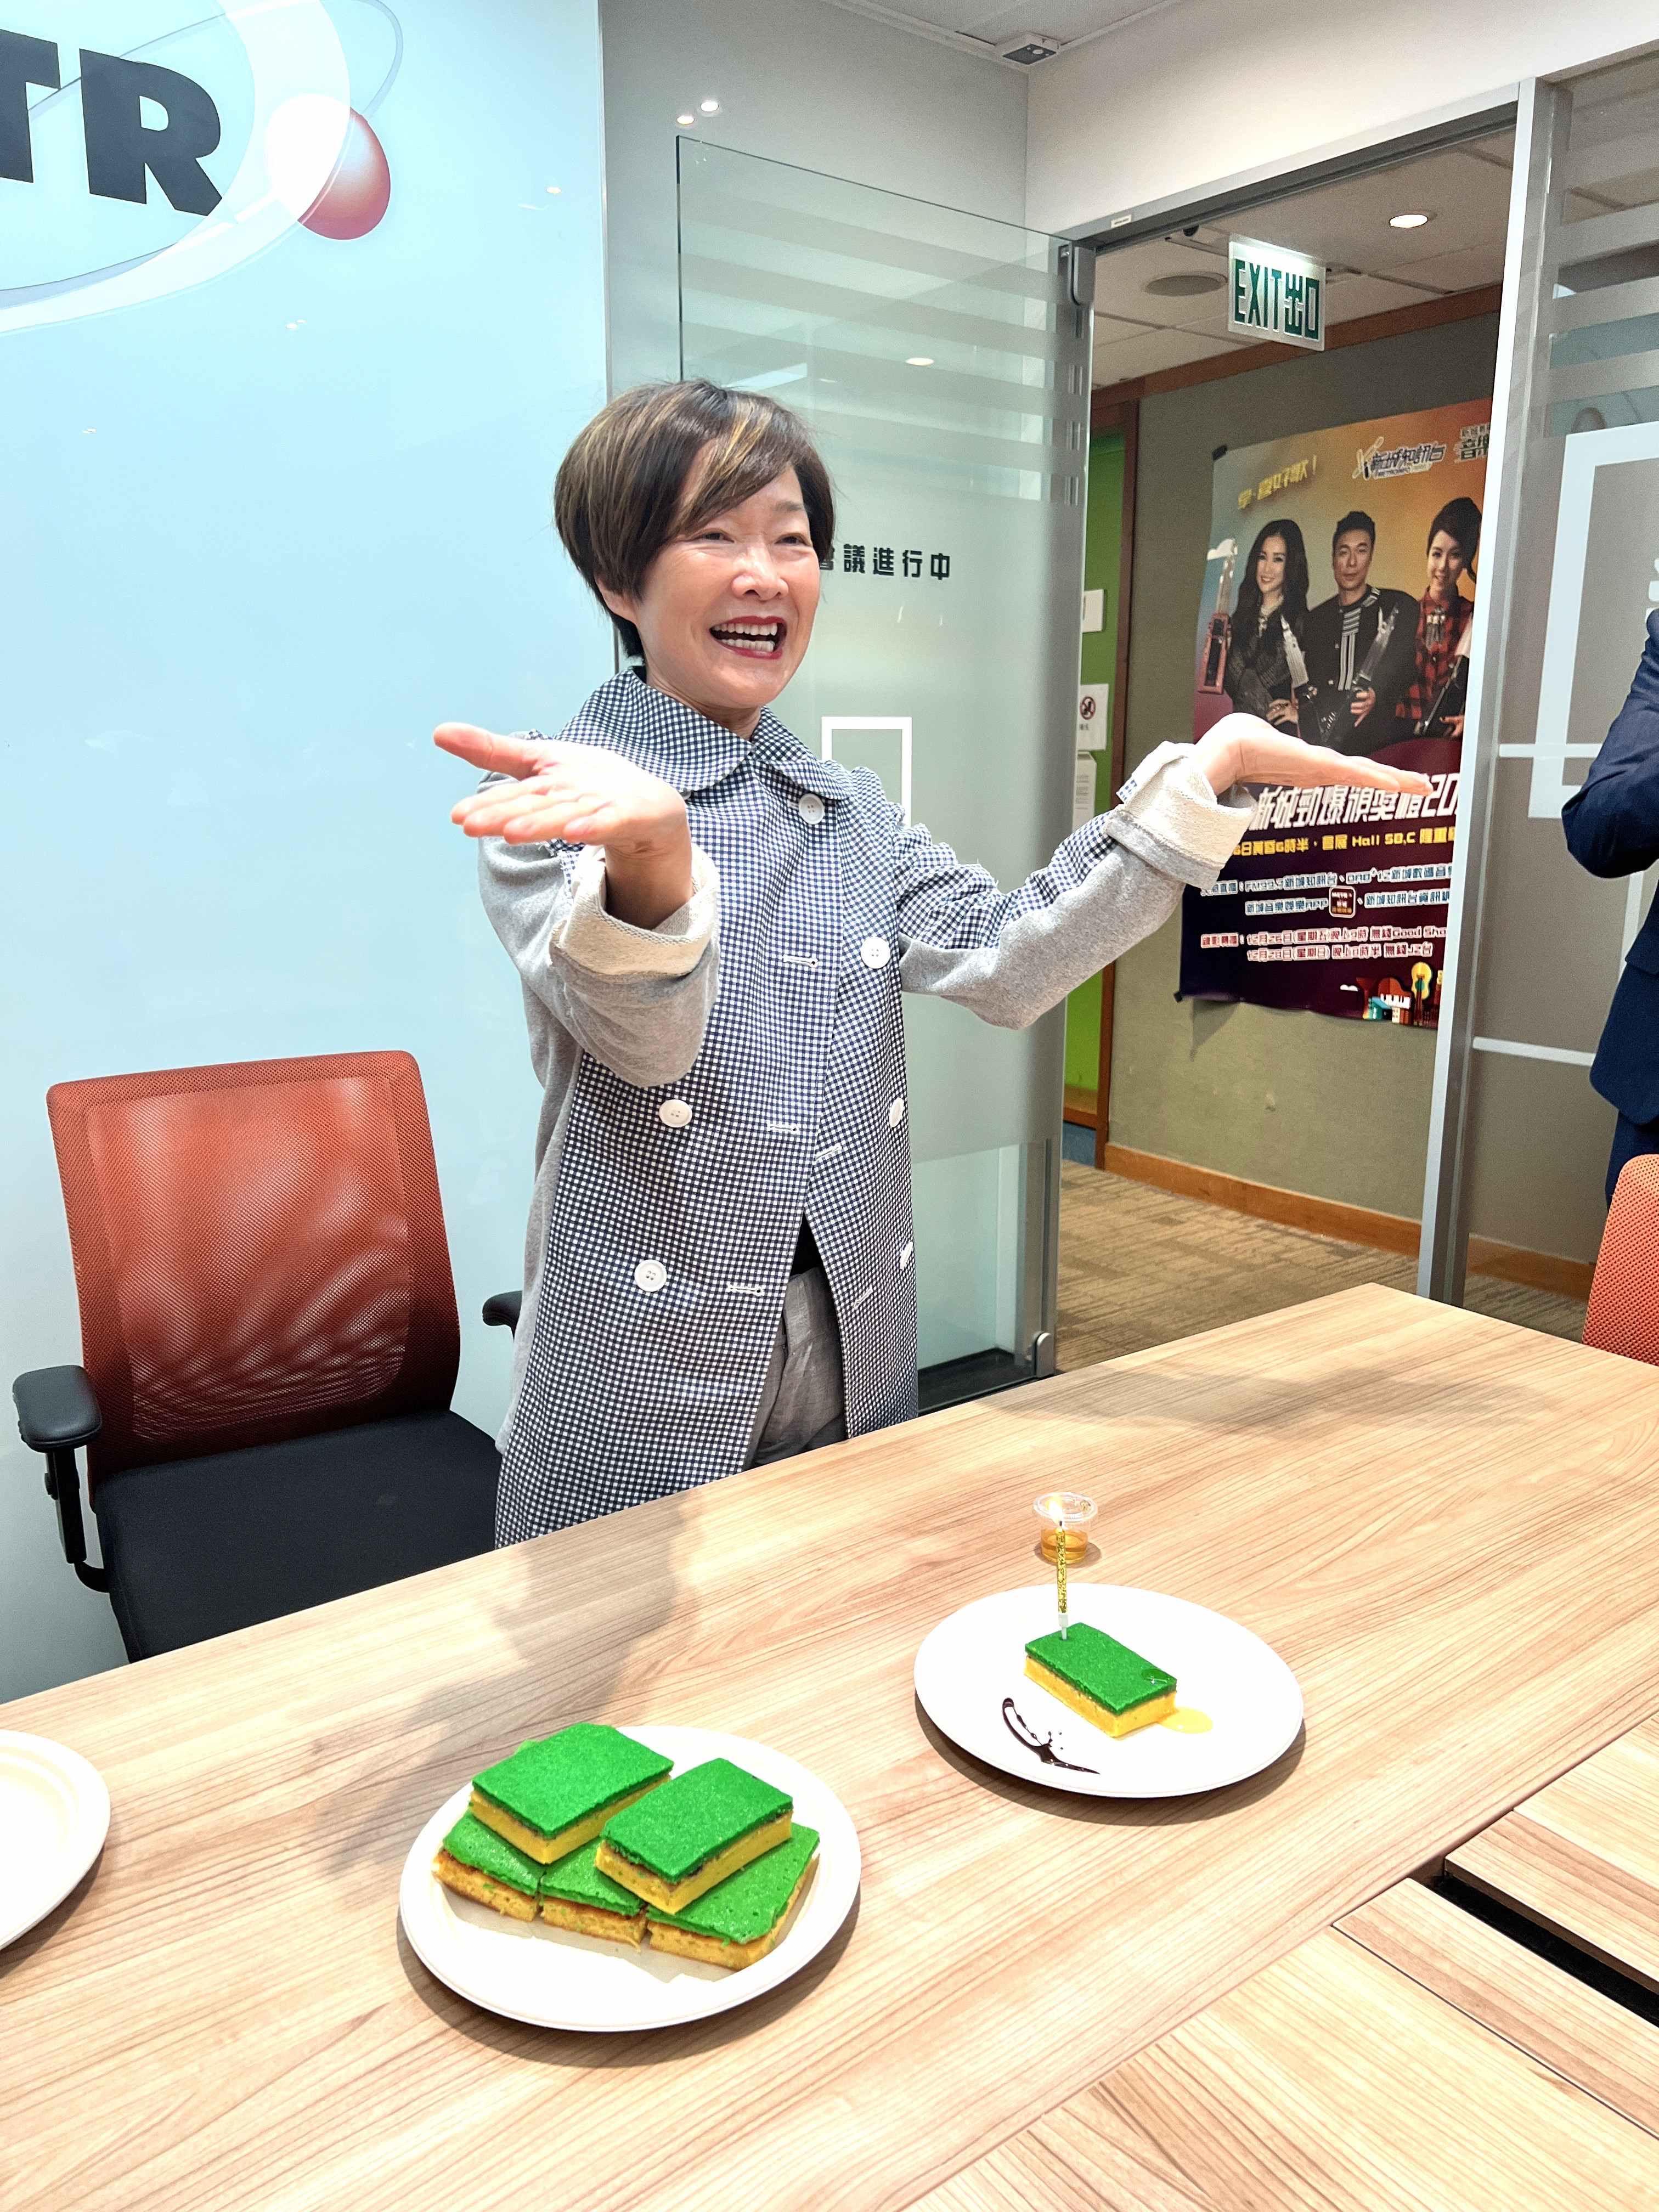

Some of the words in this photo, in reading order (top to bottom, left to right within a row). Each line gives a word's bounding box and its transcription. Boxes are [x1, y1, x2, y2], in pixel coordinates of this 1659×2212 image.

[1234, 258, 1282, 331] EXIT
[1248, 772, 1460, 831] 新城勁爆頒獎禮20
[1352, 834, 1380, 847] Hall
